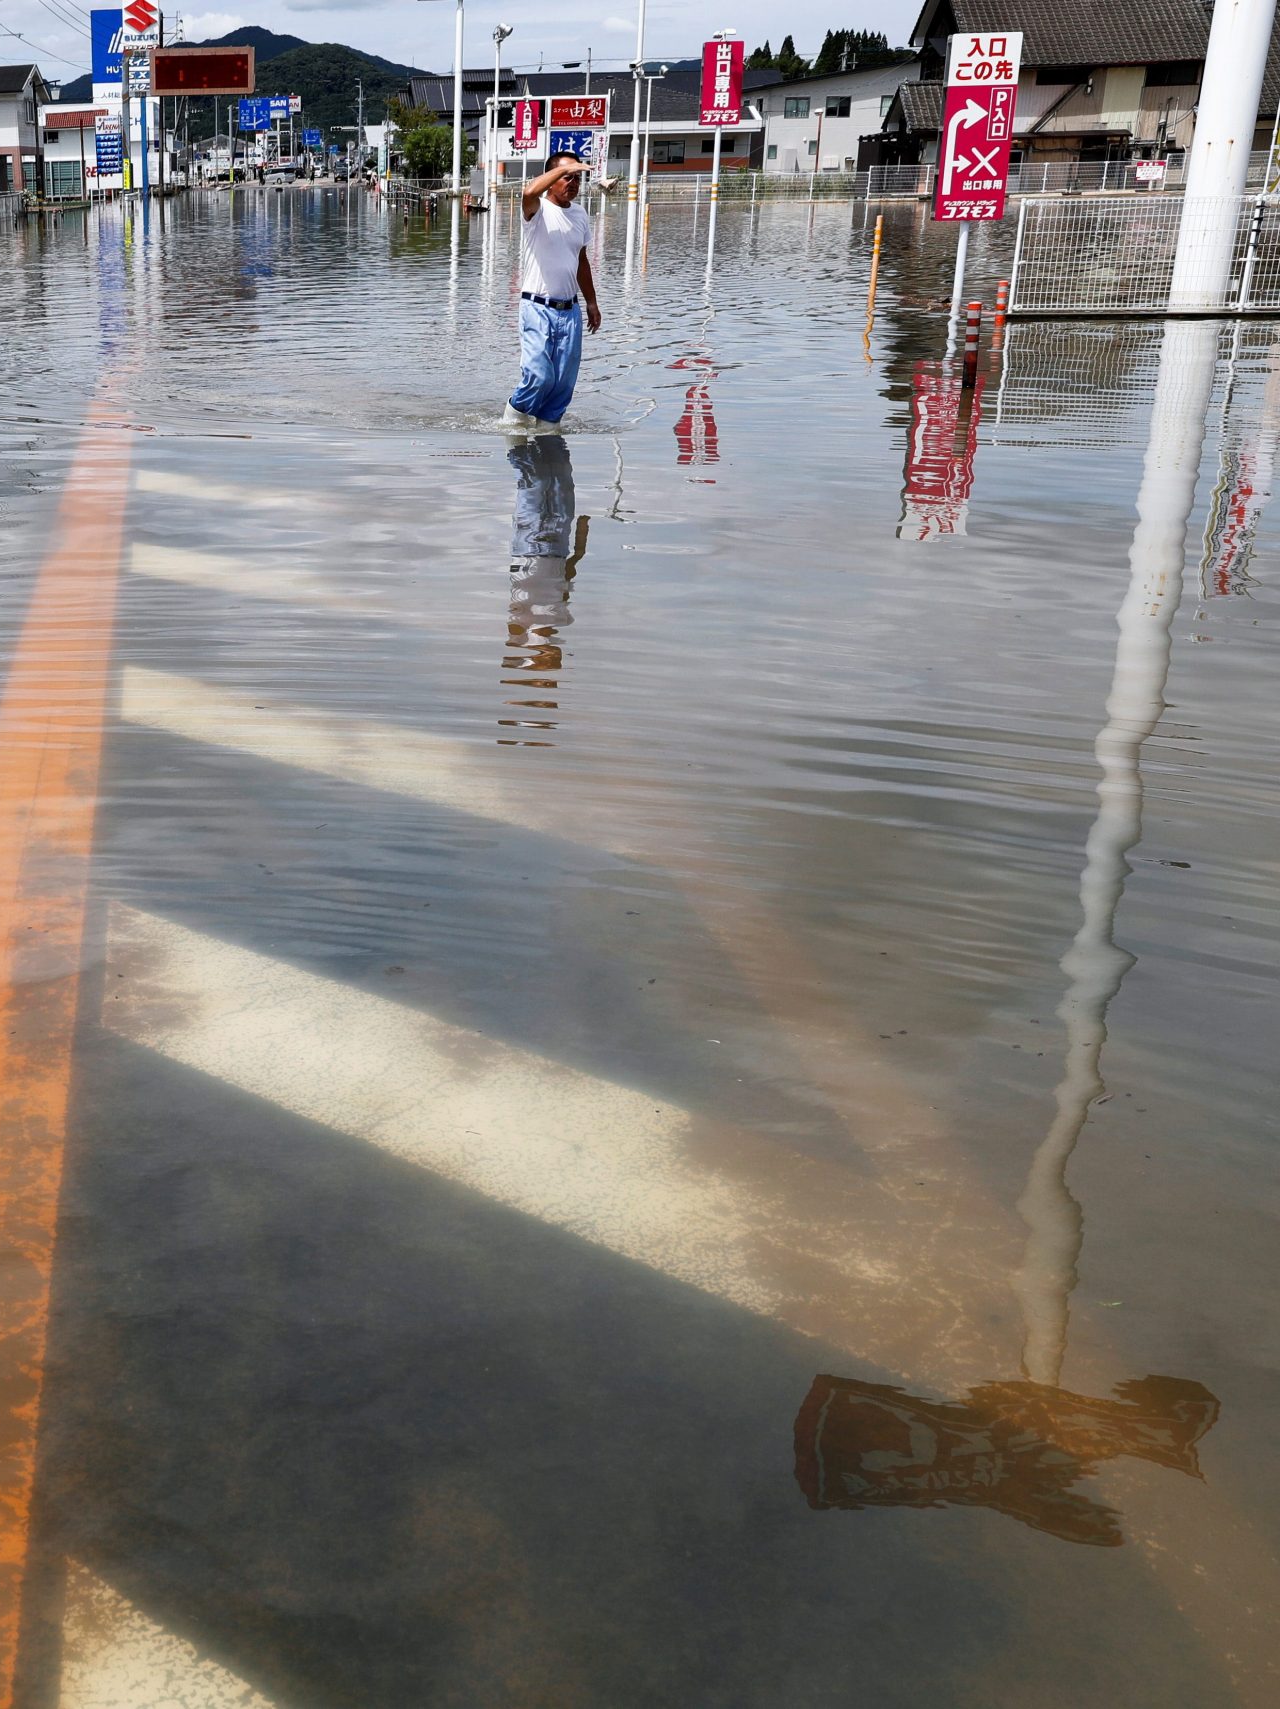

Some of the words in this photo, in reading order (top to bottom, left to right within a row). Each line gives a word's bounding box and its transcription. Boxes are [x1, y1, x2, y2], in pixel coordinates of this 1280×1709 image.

[124, 33, 159, 42] SUZUKI
[967, 38, 1006, 57] 入口
[106, 65, 123, 74] HU
[714, 44, 732, 108] 出口専用
[955, 60, 1013, 80] この先
[522, 102, 532, 140] 入口専用
[701, 113, 739, 123] コスモス
[962, 180, 1003, 191] 出口専用
[942, 205, 997, 219] コスモス
